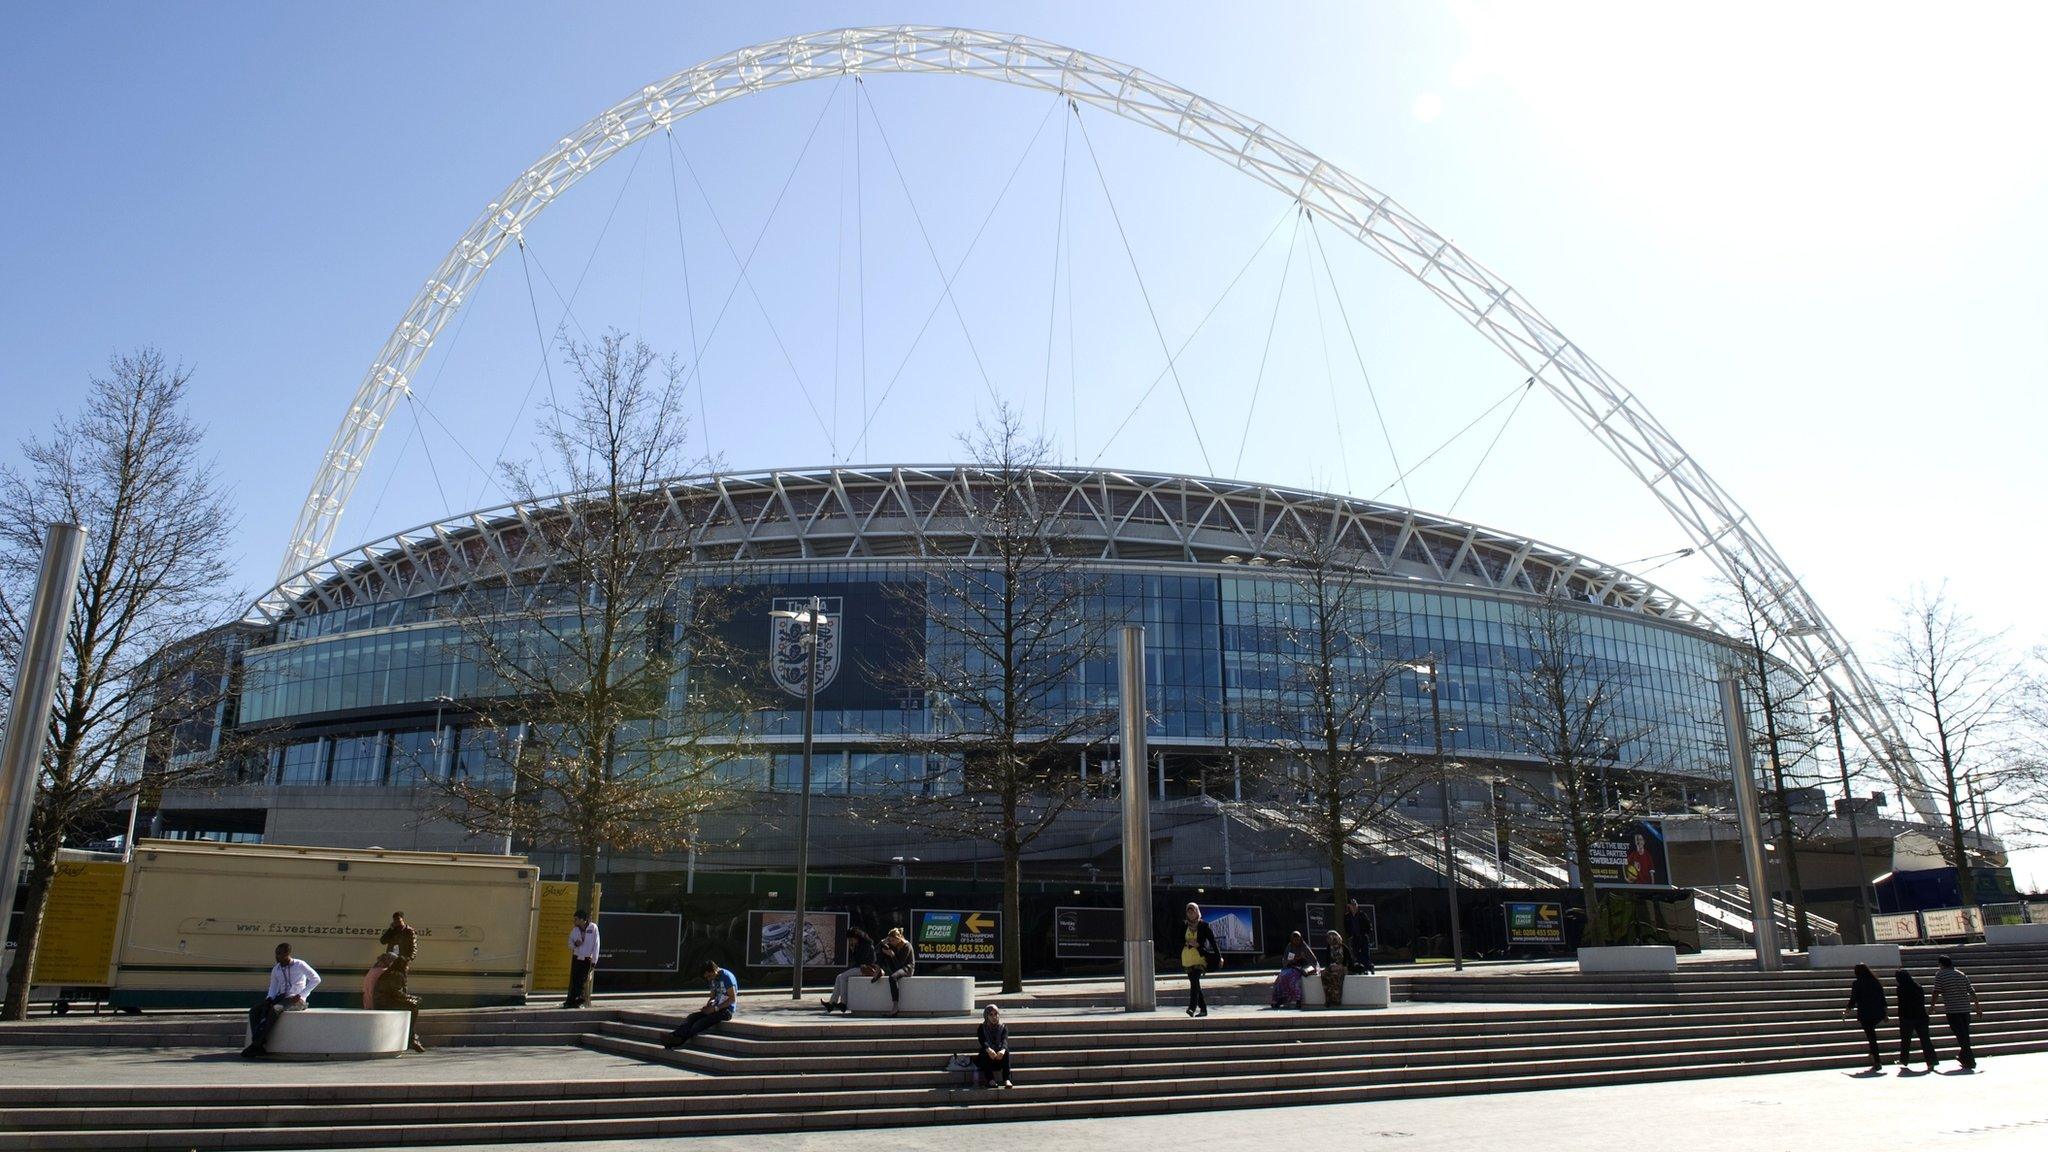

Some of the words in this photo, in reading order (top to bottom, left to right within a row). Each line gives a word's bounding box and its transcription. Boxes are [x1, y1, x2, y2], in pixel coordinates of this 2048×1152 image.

[1589, 857, 1628, 865] OWERLEAGUE
[919, 944, 935, 952] Tel:
[936, 944, 956, 952] 0208
[958, 945, 973, 953] 453
[974, 945, 994, 953] 5300
[919, 952, 994, 960] www.powerleague.co.uk
